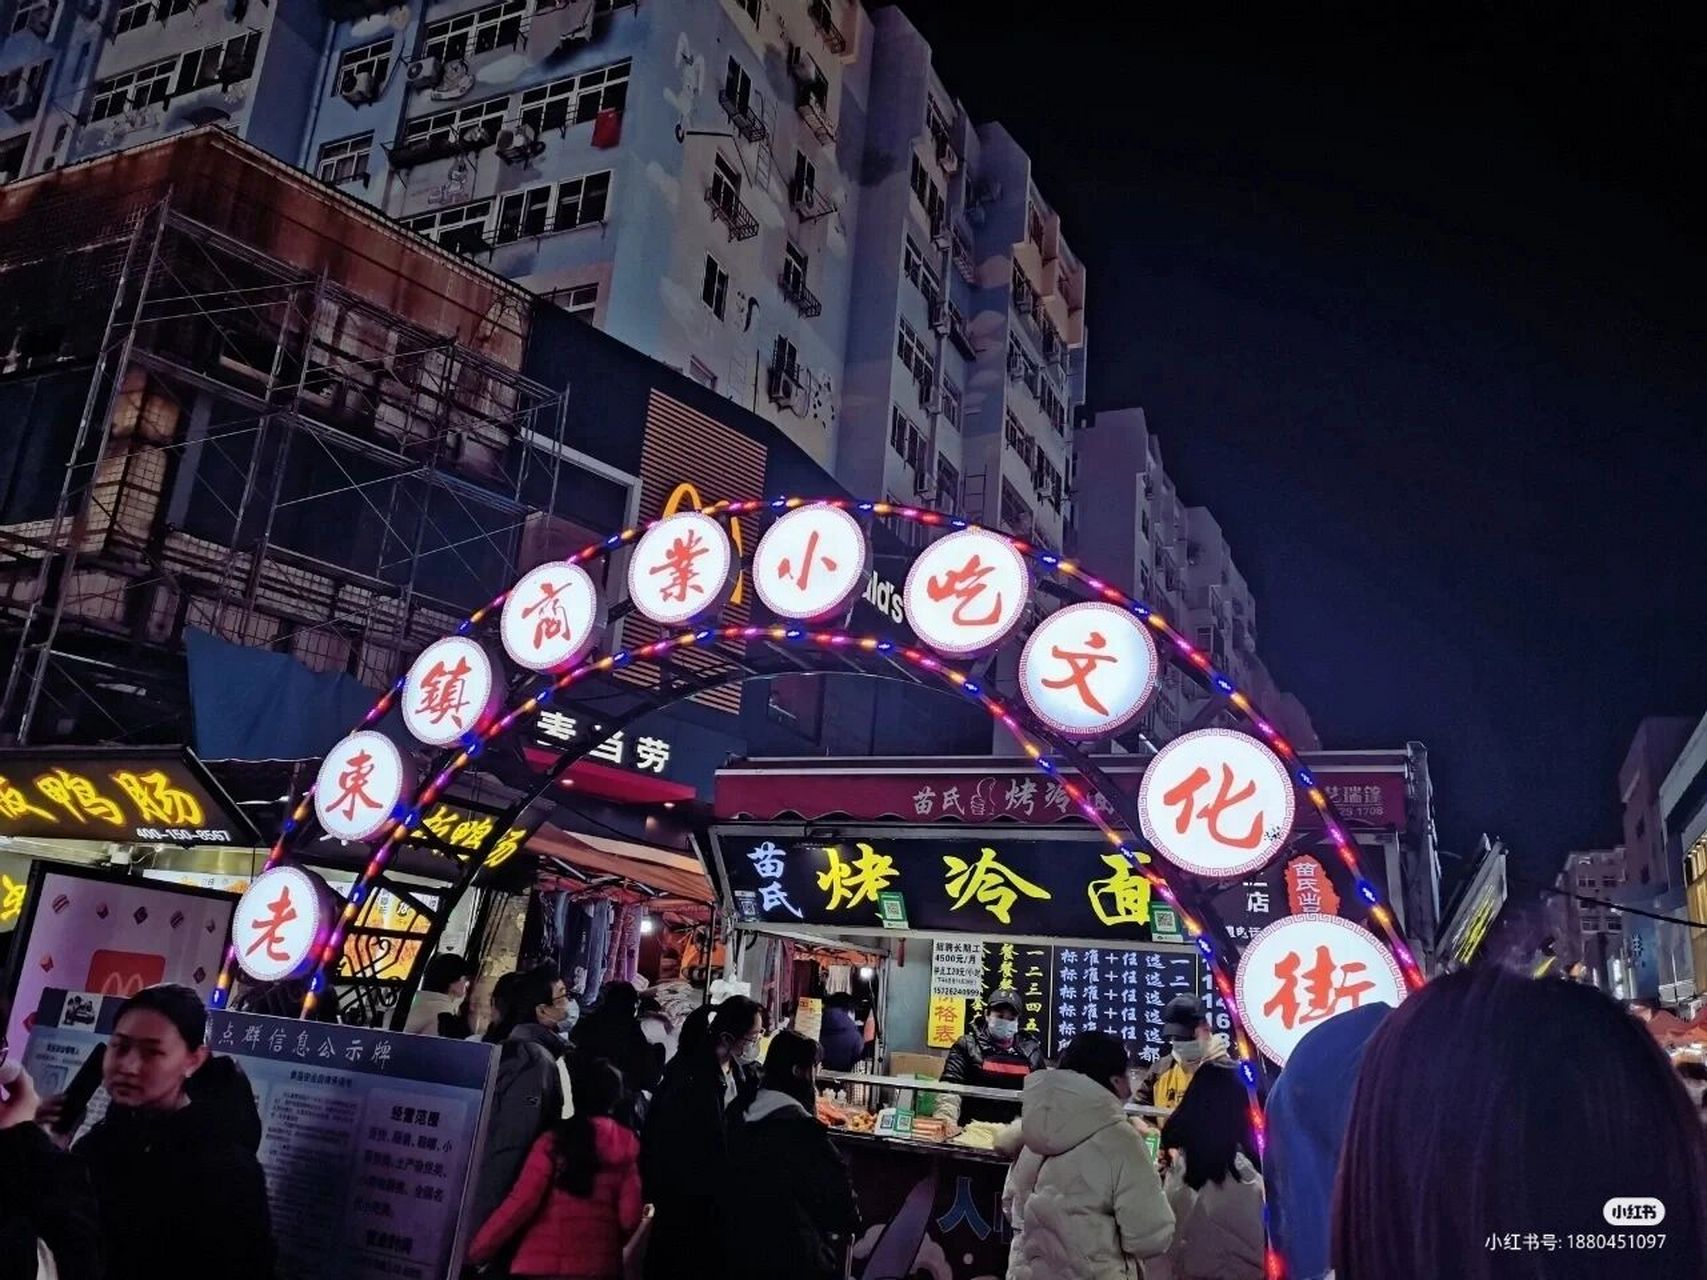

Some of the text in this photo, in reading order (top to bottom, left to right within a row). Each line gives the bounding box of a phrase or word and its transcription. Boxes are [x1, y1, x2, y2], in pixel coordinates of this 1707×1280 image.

[912, 785, 966, 816] 苗氏
[136, 828, 232, 843] 400-150-8567
[746, 841, 804, 919] 苗氏
[815, 841, 1152, 926] 烤冷面
[1059, 984, 1184, 1007] 标准+任选
